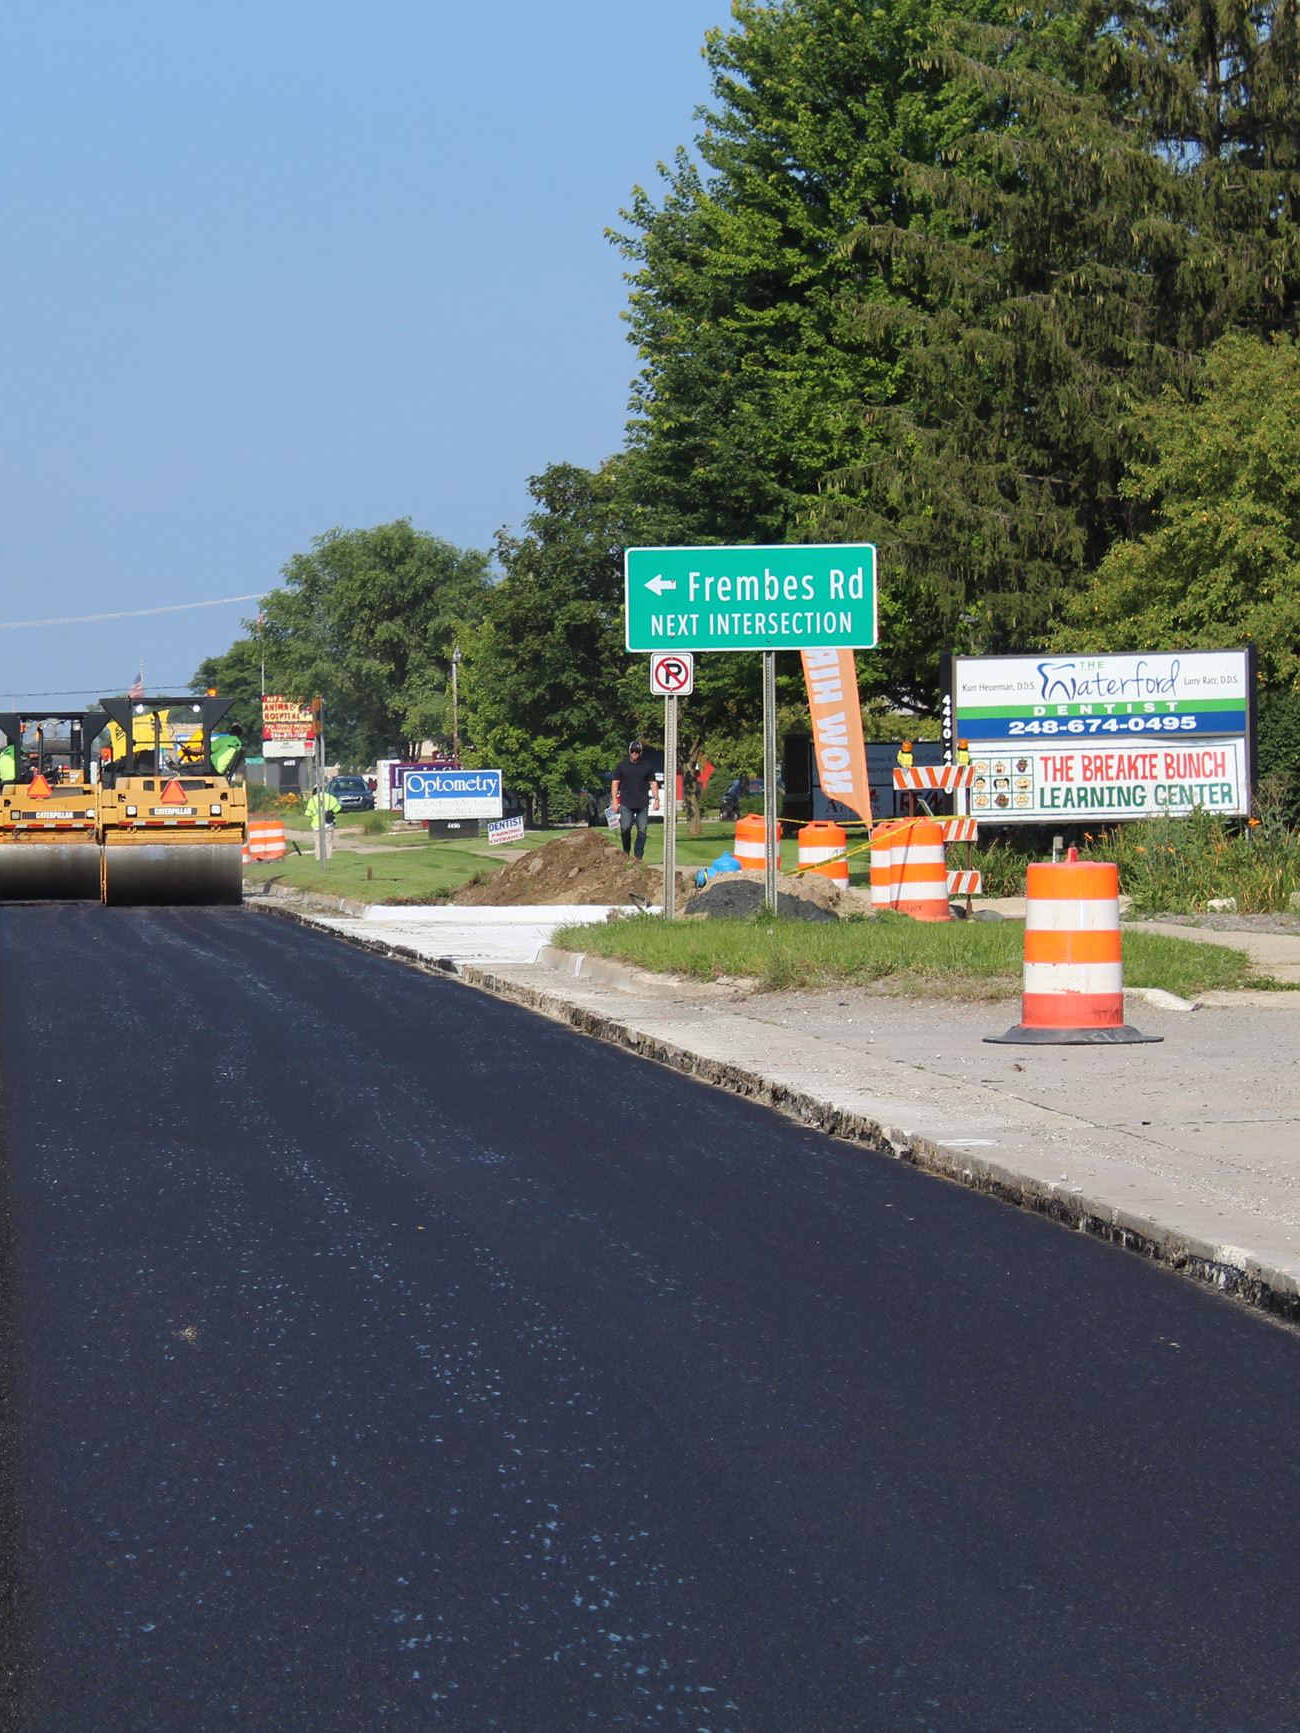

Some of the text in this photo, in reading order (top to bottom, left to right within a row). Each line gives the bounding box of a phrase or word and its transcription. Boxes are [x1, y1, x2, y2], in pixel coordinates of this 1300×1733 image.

[688, 567, 864, 602] Frembes Rd
[651, 611, 852, 636] NEXT INTERSECTION
[1080, 661, 1104, 669] THE
[962, 682, 1036, 692] Kurt Heuerman, D.D.S.
[1037, 659, 1180, 701] Waterford
[1184, 675, 1238, 686] Larry Ratz, D.D.S.
[264, 712, 301, 720] HOSPITAL
[1033, 702, 1179, 717] DENTIST
[1008, 716, 1197, 735] 248-674-0495
[1039, 751, 1226, 782] THE BREAKIE BUNCH
[407, 775, 498, 798] Optometry
[1039, 782, 1234, 810] LEARNING CENTER
[35, 811, 73, 819] CATERPILLAR
[154, 807, 192, 815] CATERPILLAR
[489, 817, 522, 832] DENTIST
